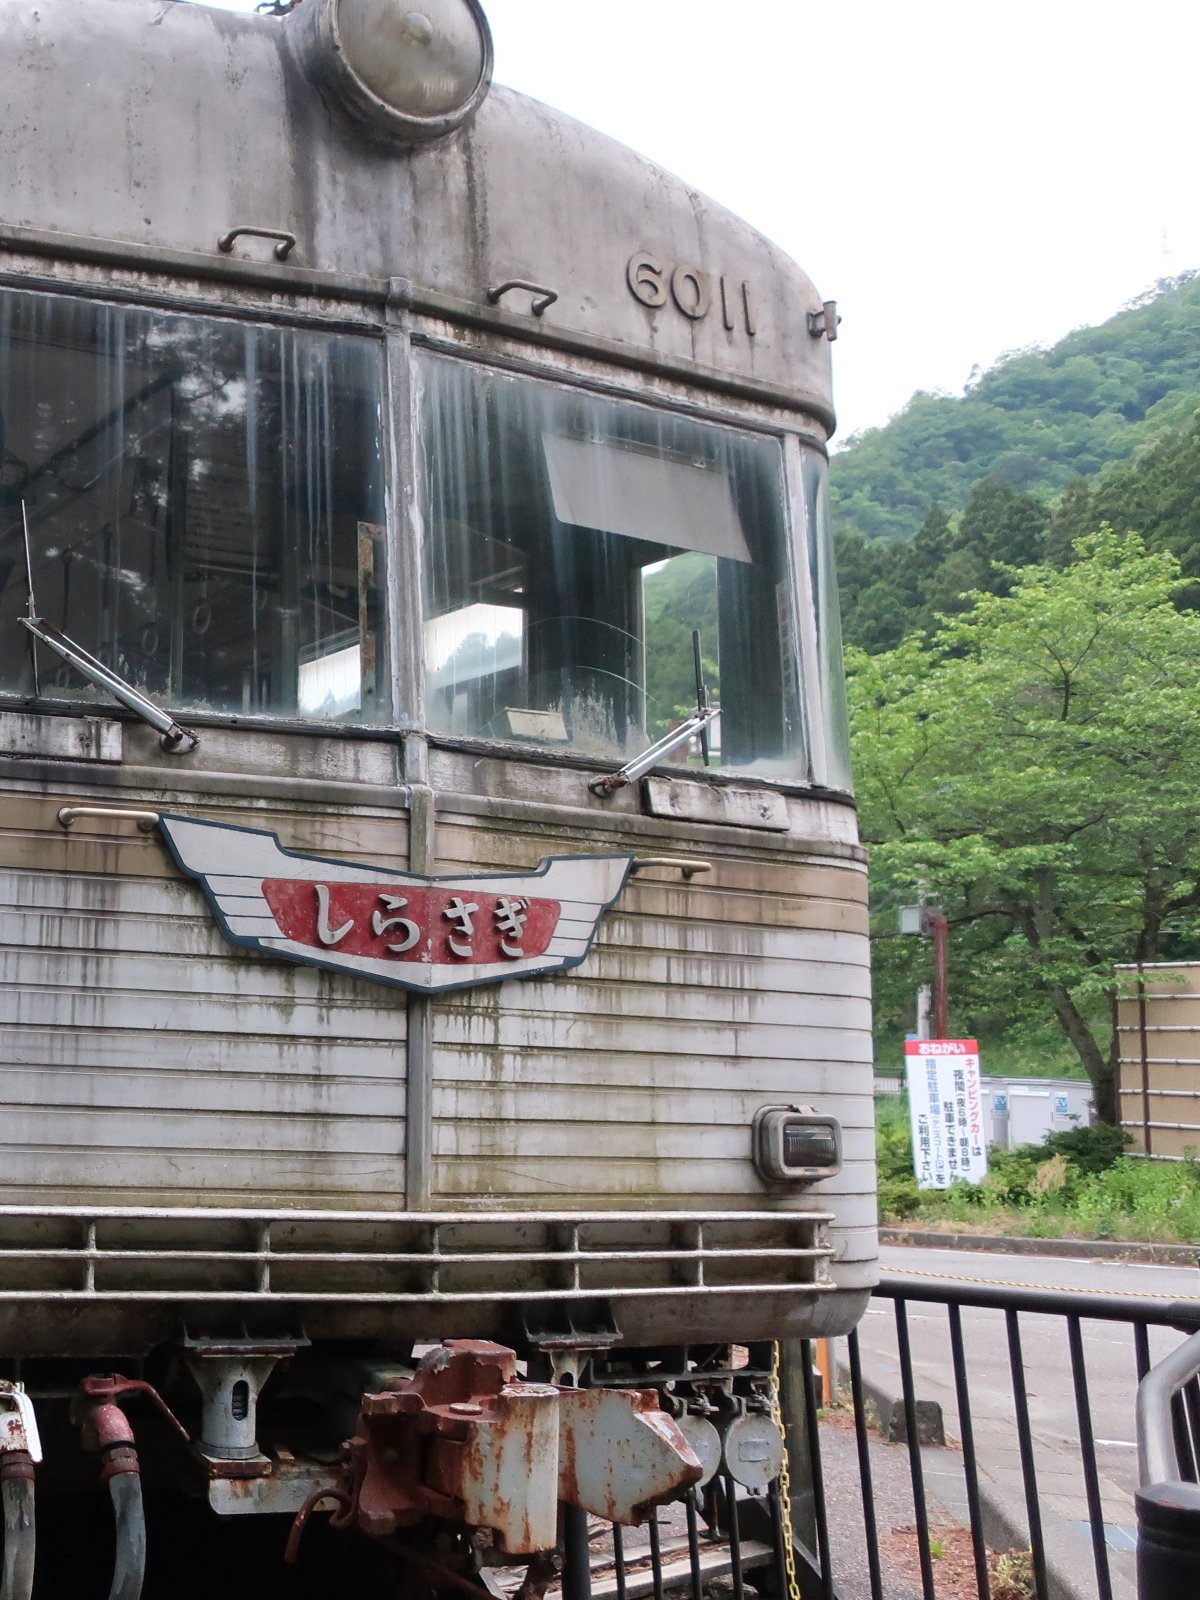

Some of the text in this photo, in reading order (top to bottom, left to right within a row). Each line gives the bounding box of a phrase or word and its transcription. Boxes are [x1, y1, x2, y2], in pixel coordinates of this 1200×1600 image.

[626, 251, 757, 336] 6011
[314, 884, 533, 958] しらさぎ
[918, 1043, 965, 1055] おねがい
[918, 1114, 933, 1182] ご利用下さい
